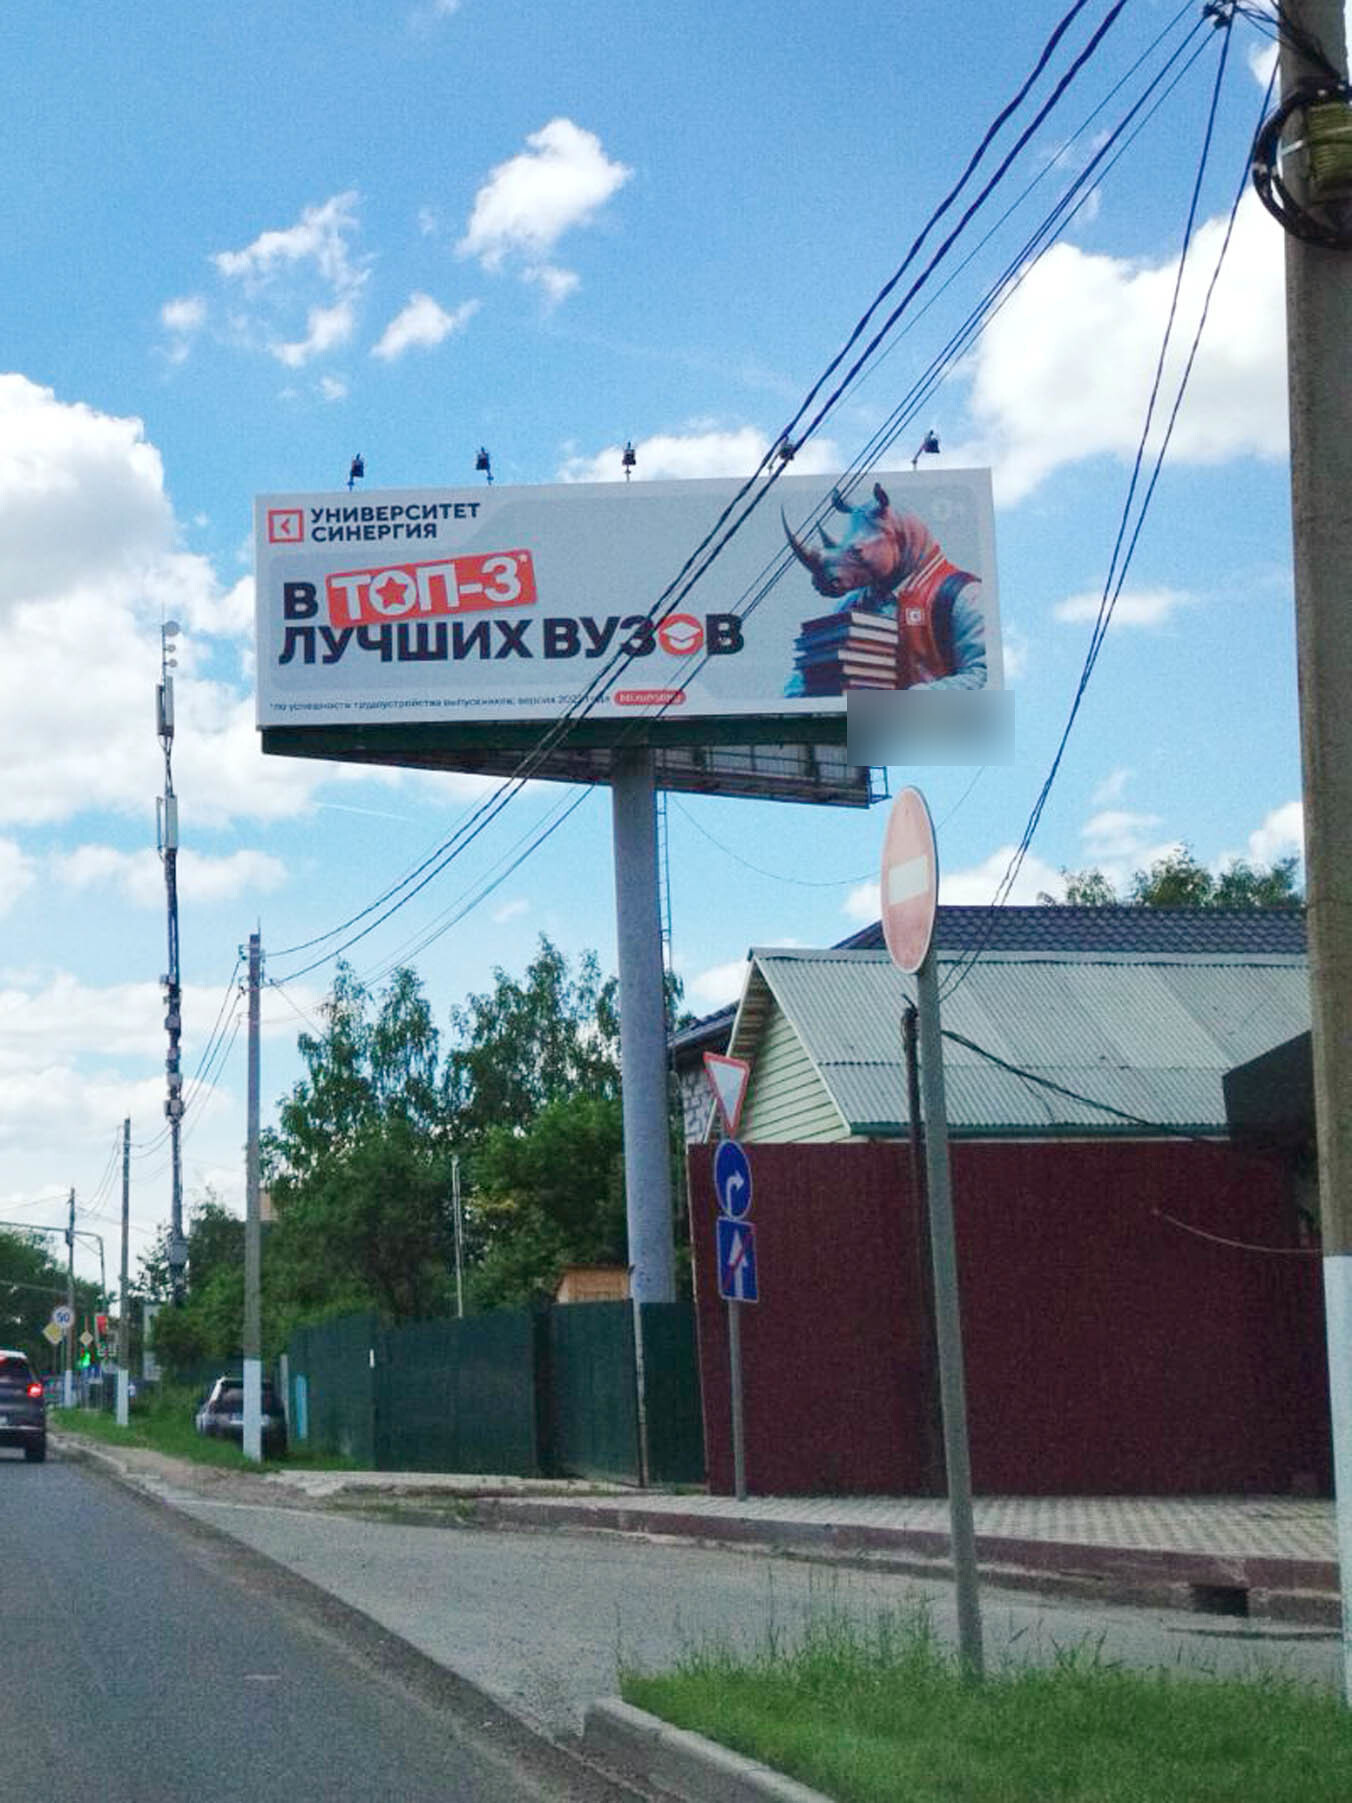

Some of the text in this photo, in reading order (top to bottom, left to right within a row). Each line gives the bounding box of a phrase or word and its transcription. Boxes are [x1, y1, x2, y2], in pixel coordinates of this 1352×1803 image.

[311, 502, 480, 524] УНИВЕРСИТЕТ
[311, 523, 437, 543] СИНЕРГИЯ
[283, 582, 319, 620] В
[279, 613, 744, 665] ЛУЧШИХ ВУЗОВ
